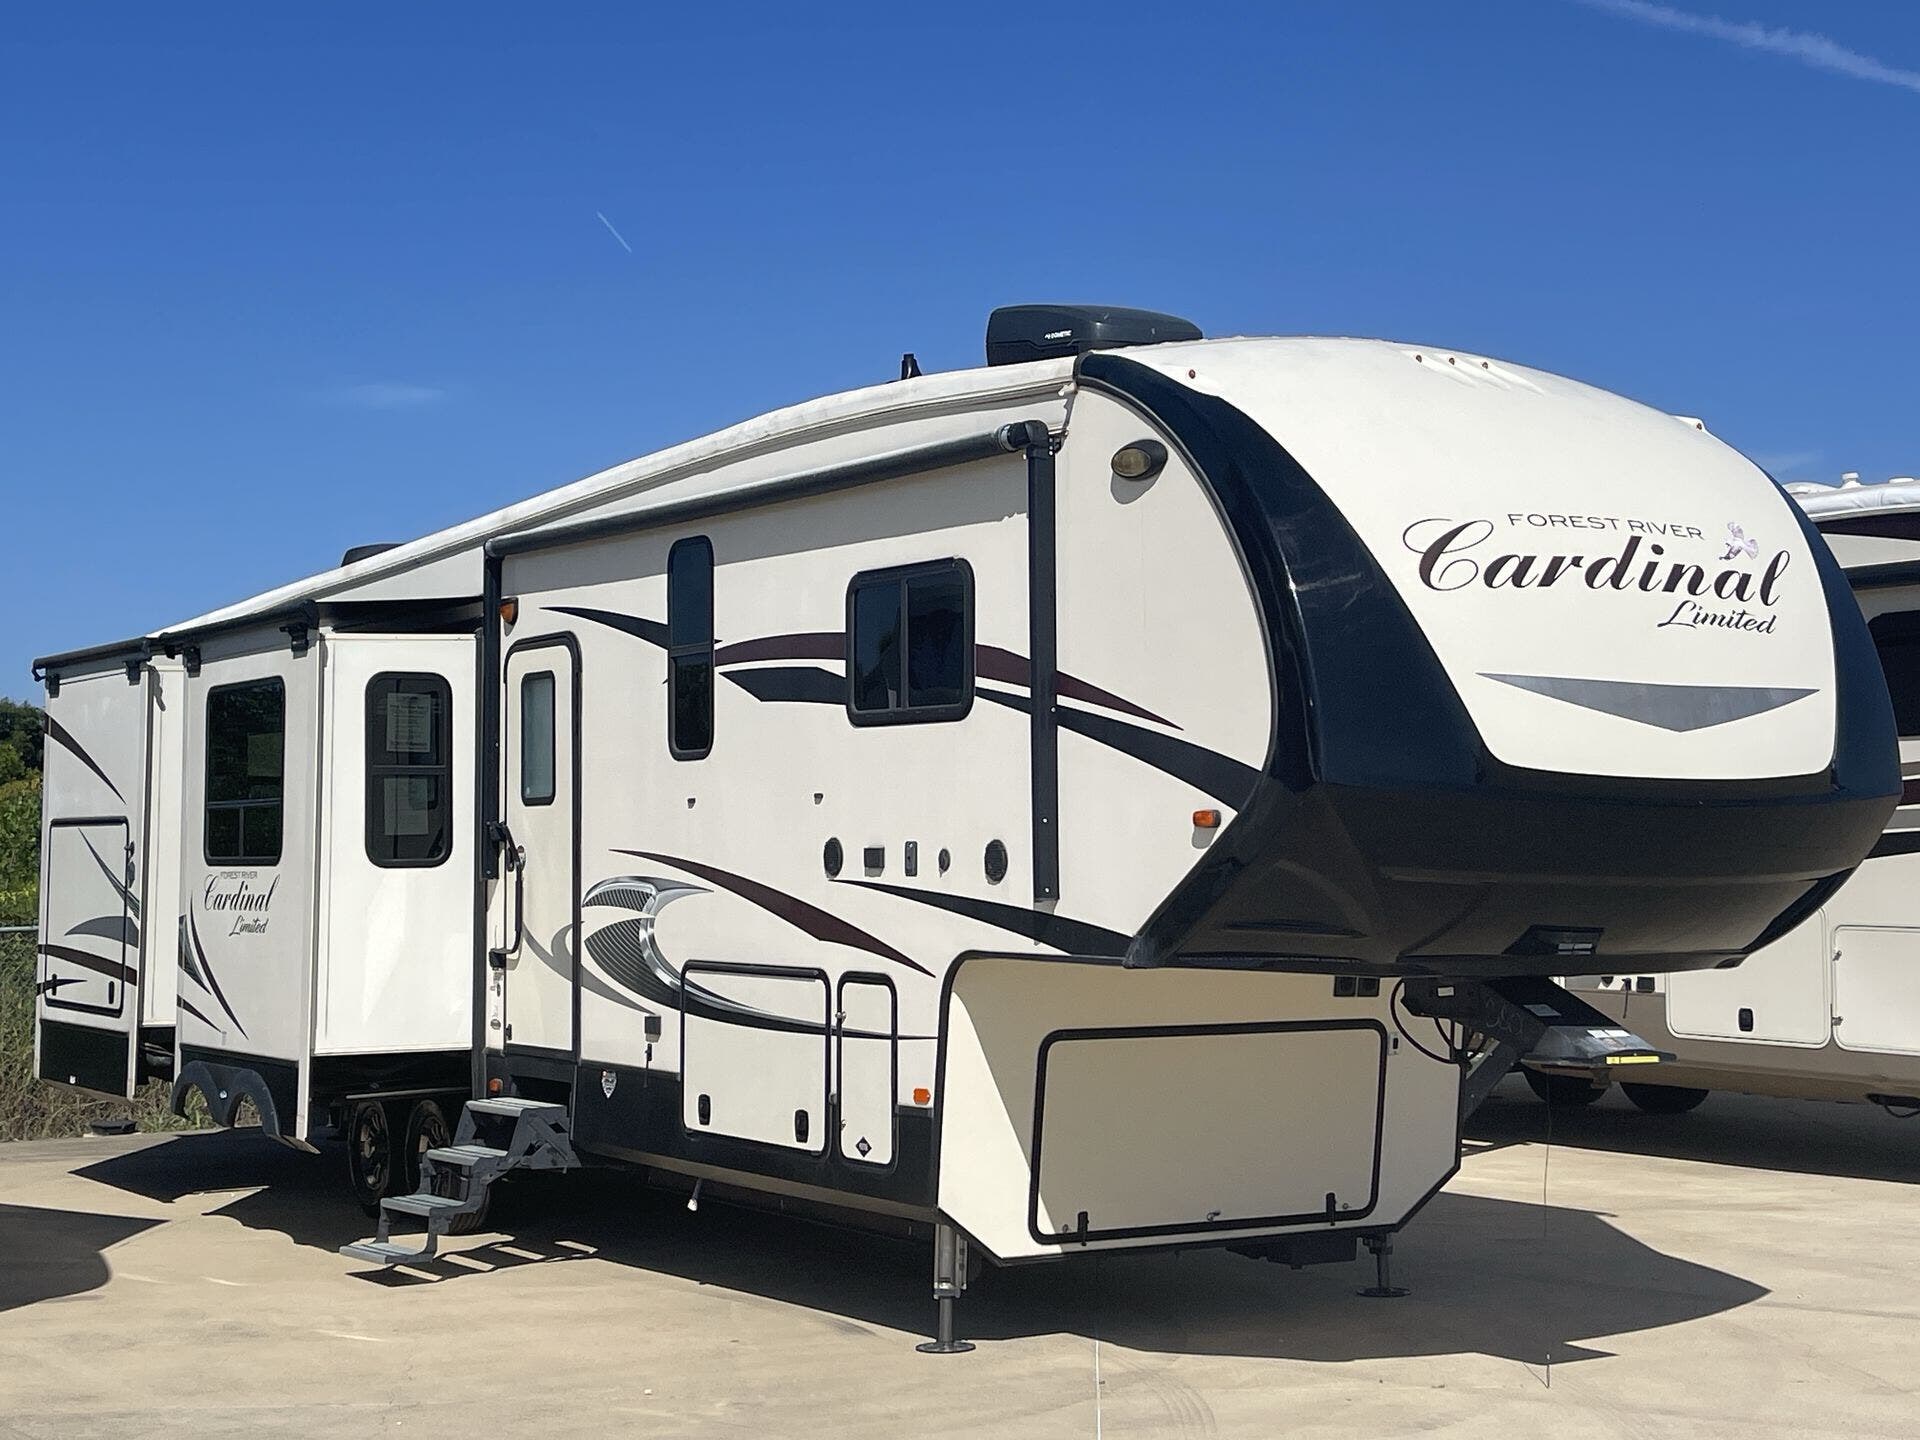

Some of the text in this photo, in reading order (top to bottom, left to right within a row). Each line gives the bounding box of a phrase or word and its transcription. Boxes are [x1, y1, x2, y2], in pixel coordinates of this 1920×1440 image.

[1507, 513, 1705, 540] FOREST RIVER
[1402, 518, 1791, 607] Cardinal
[1657, 599, 1777, 635] Limited
[204, 874, 280, 912] Cardinal
[229, 915, 269, 937] Limited
